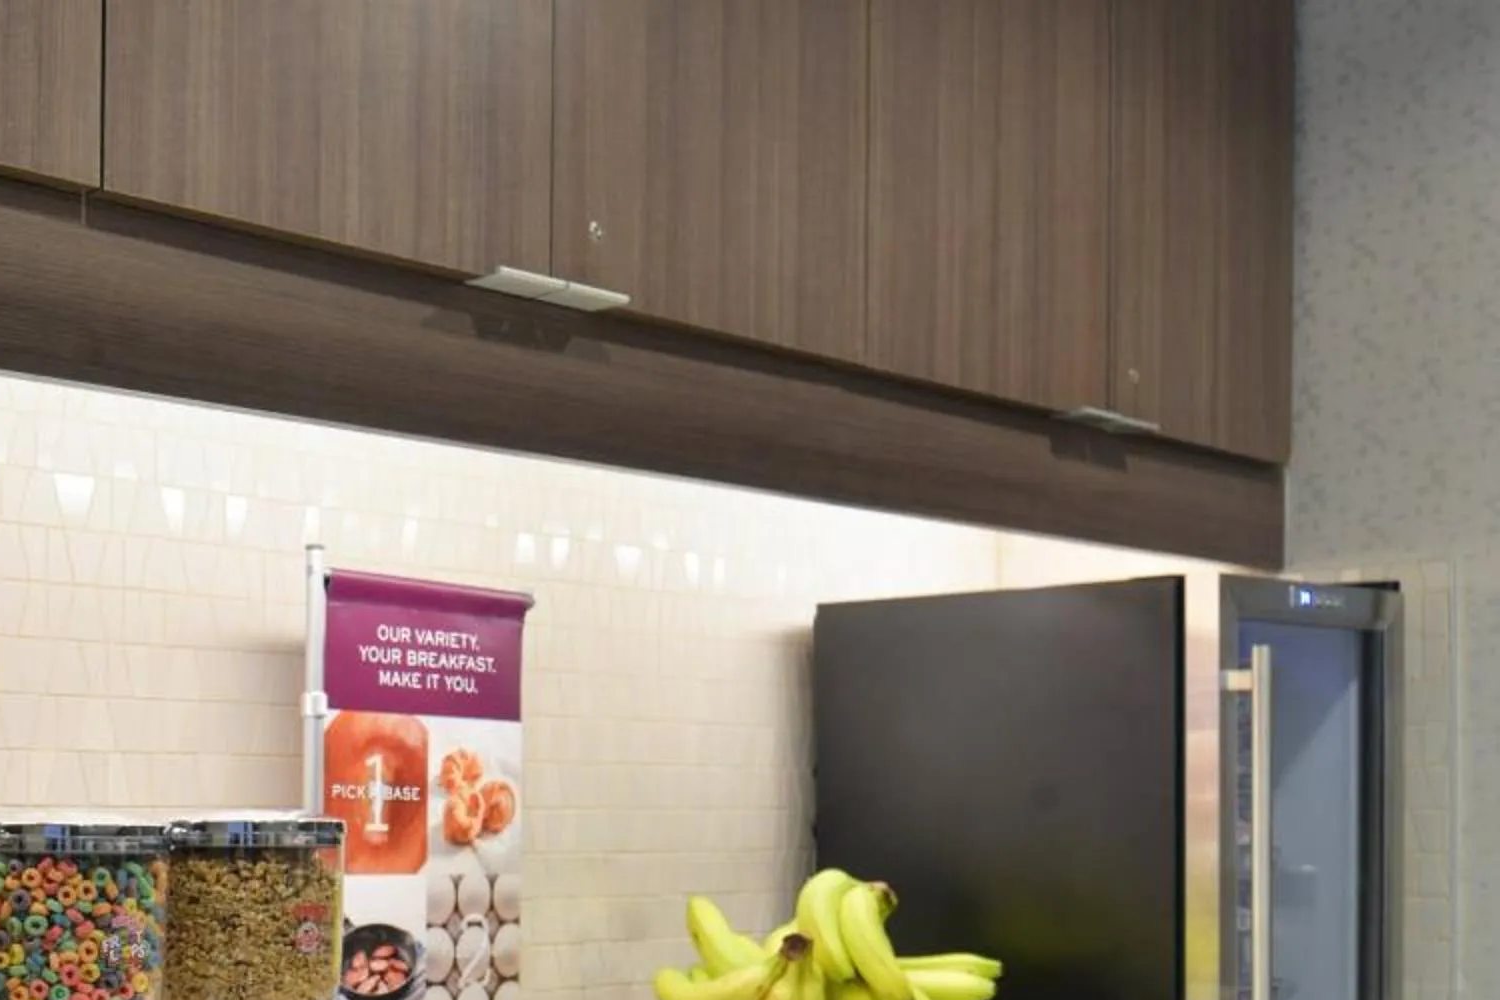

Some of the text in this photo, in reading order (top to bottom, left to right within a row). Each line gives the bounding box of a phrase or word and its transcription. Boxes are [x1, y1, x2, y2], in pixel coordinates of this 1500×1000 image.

[377, 624, 480, 651] OUR VARIETY.
[359, 645, 497, 673] YOUR BREAKFAST.
[379, 670, 478, 694] MAKE IT YOU.
[332, 784, 365, 800] PICK
[384, 785, 421, 801] BASE
